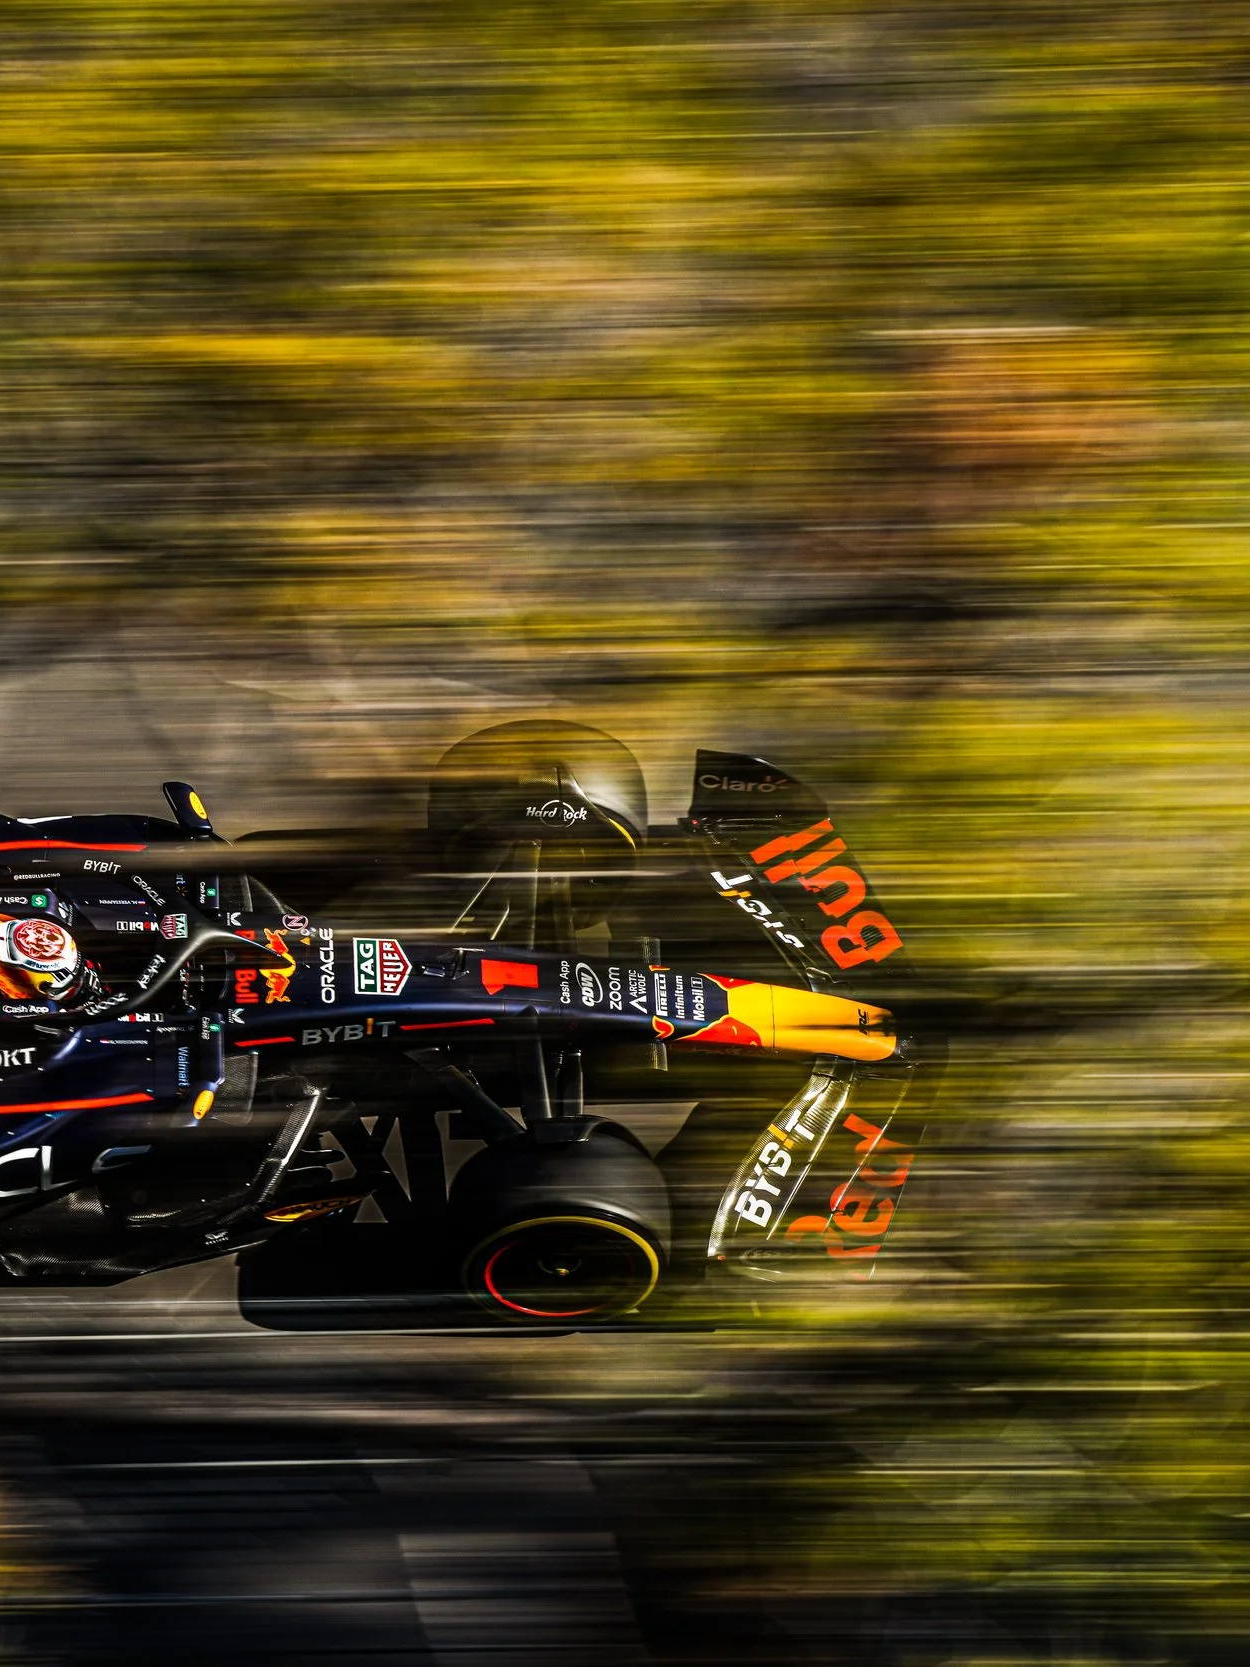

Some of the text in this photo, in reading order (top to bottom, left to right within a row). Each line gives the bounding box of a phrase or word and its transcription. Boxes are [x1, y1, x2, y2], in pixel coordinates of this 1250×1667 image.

[699, 775, 778, 793] Claro
[525, 806, 558, 818] Hard
[83, 859, 121, 875] BYBIT
[3, 896, 28, 905] Cash
[131, 874, 166, 907] ORACLE
[750, 817, 904, 970] Bull
[130, 921, 160, 931] Mobil
[319, 927, 336, 1004] ORACLE
[359, 943, 376, 990] TAG
[382, 942, 404, 992] HEUER
[481, 959, 540, 995] 1
[560, 960, 571, 1004] Cash App
[235, 969, 259, 1004] Bull
[580, 972, 595, 1007] CDW
[629, 969, 638, 998] ARCTIC
[637, 973, 647, 997] WOLF
[654, 972, 669, 1017] PIRELLI
[3, 1004, 50, 1014] Cash App
[691, 989, 705, 1022] Mobil
[302, 1017, 396, 1046] BYBIT
[177, 1046, 191, 1087] Walmart
[734, 1108, 815, 1229] BYBIT
